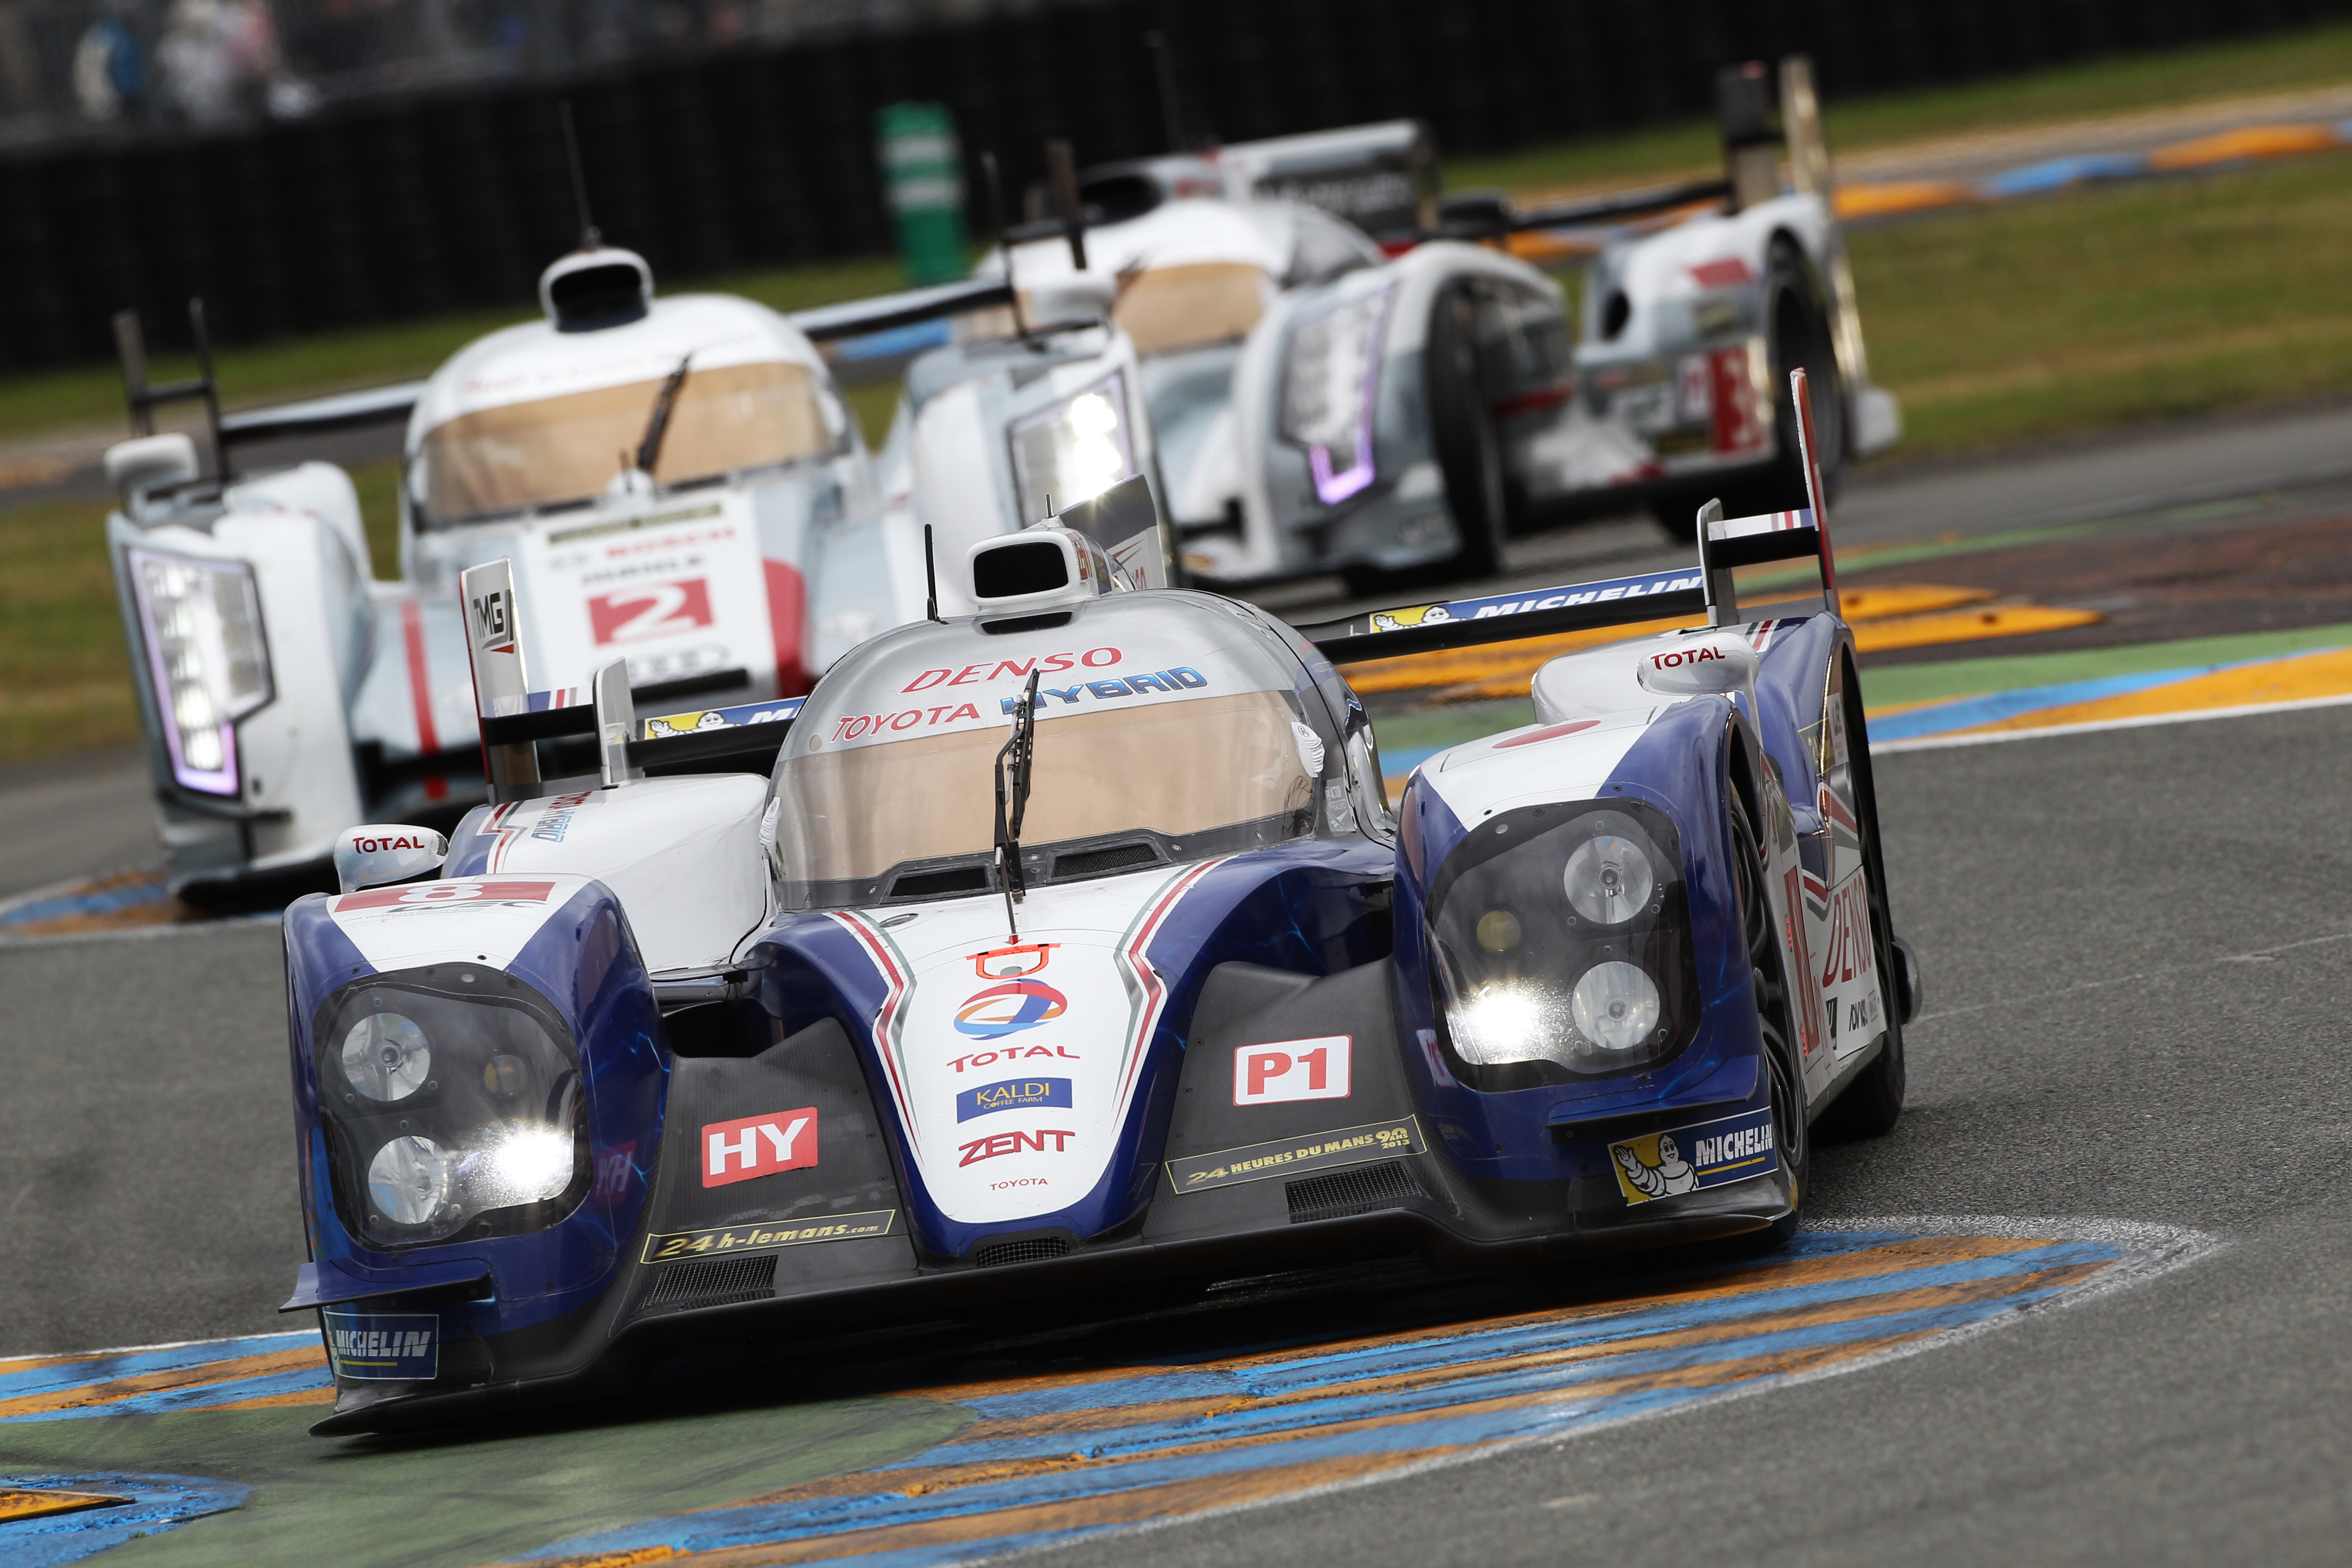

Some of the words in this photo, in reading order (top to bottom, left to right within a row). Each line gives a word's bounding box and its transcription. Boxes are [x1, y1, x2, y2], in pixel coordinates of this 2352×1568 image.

[607, 583, 698, 643] 2
[1473, 576, 1703, 620] MICHELIN
[900, 647, 1123, 695] DENSO
[1651, 646, 1725, 670] TOTAL
[830, 703, 981, 743] TOYOTA
[1000, 666, 1209, 715] HYBRID
[353, 836, 425, 854] TOTAL
[398, 884, 484, 902] 8
[1822, 873, 1872, 988] DENSO
[946, 1045, 1080, 1073] TOTAL
[1247, 1047, 1327, 1096] P1
[977, 1082, 1050, 1105] KALDI
[709, 1117, 810, 1176] HY
[958, 1129, 1076, 1168] ZENT
[1381, 1139, 1410, 1150] 2013
[1389, 1133, 1409, 1141] ANS
[1695, 1123, 1773, 1167] MICHELIN
[1186, 1166, 1229, 1186] 24
[1230, 1151, 1293, 1174] HEURES
[1296, 1144, 1322, 1160] DU
[1324, 1134, 1373, 1153] MANS
[990, 1178, 1048, 1191] TOYOTA
[336, 1330, 431, 1357] MICHELIN
